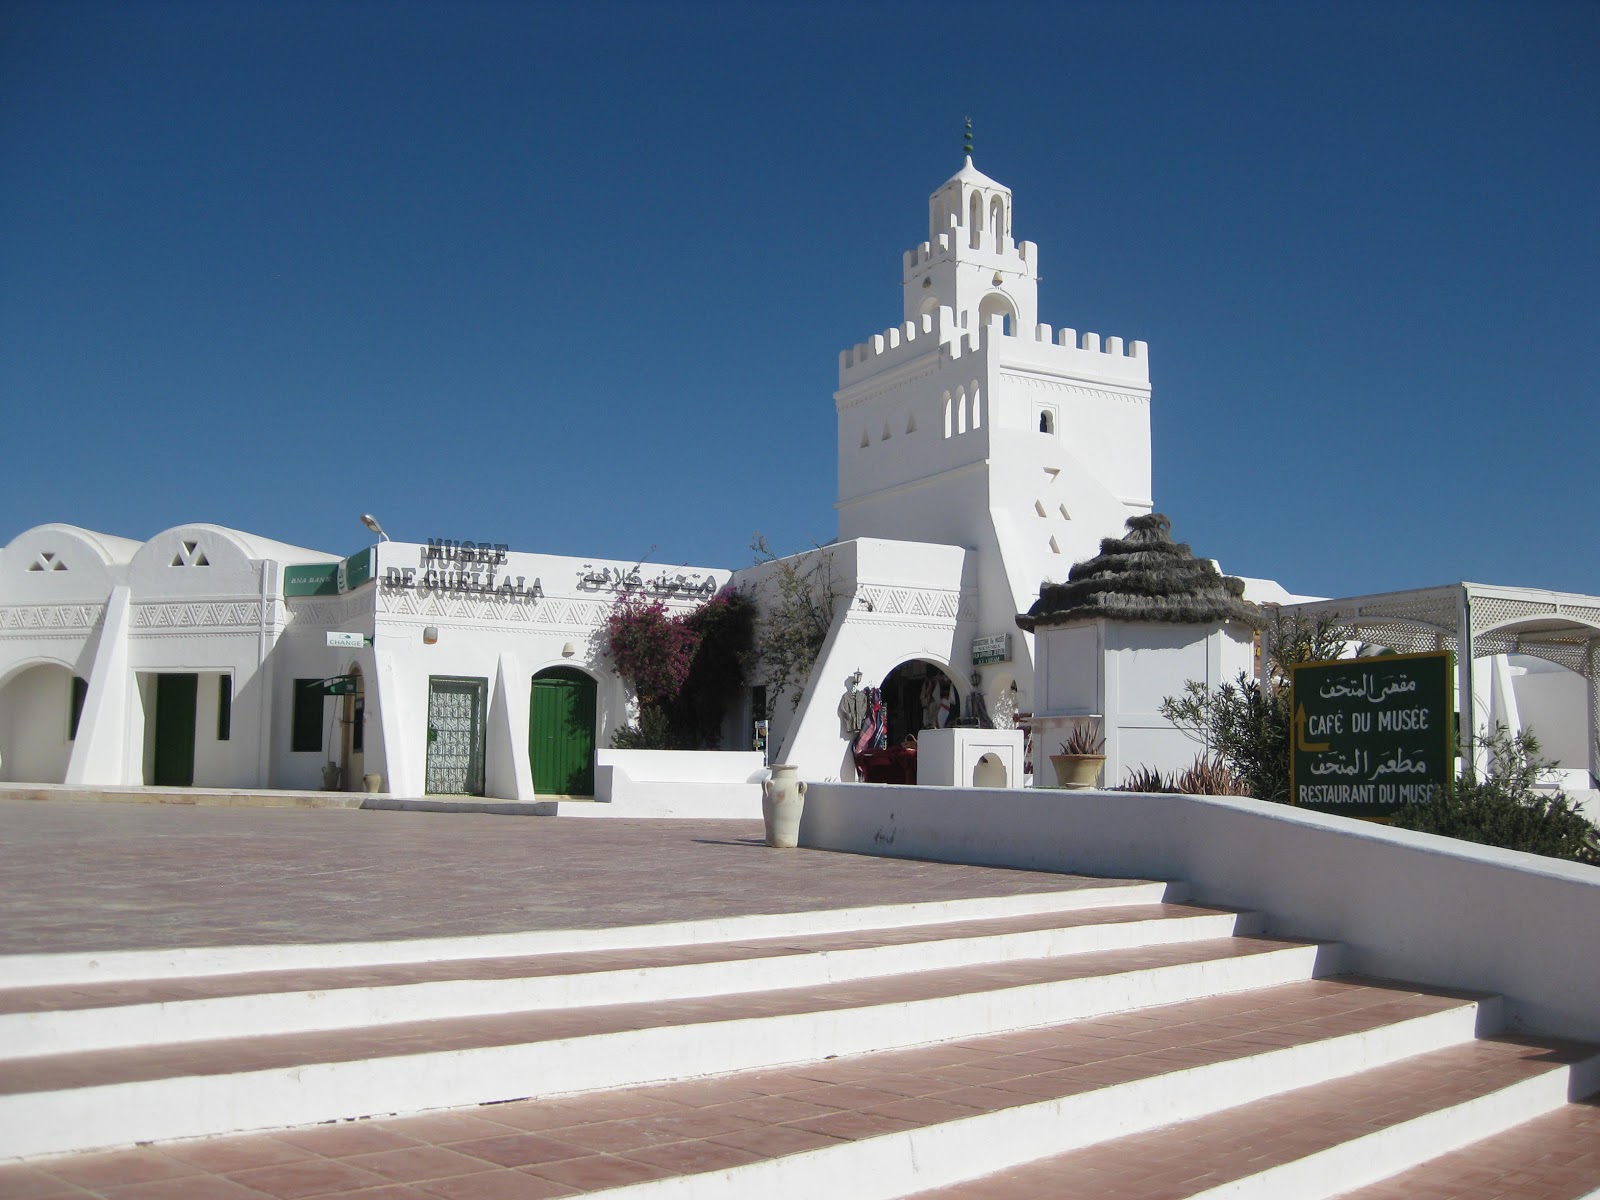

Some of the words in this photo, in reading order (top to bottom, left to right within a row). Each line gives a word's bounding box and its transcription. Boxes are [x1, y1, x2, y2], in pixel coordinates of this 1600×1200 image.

[427, 538, 509, 565] MUSEE
[385, 567, 416, 589] DE
[424, 570, 544, 598] GUELLALA
[329, 639, 361, 647] CHANGE
[1308, 710, 1344, 736] CAFÉ
[1352, 712, 1371, 733] DU
[1378, 705, 1429, 732] MUSÉE
[1299, 784, 1375, 804] RESTAURANT
[1379, 783, 1396, 804] DU
[1399, 779, 1435, 804] MUSÉ
